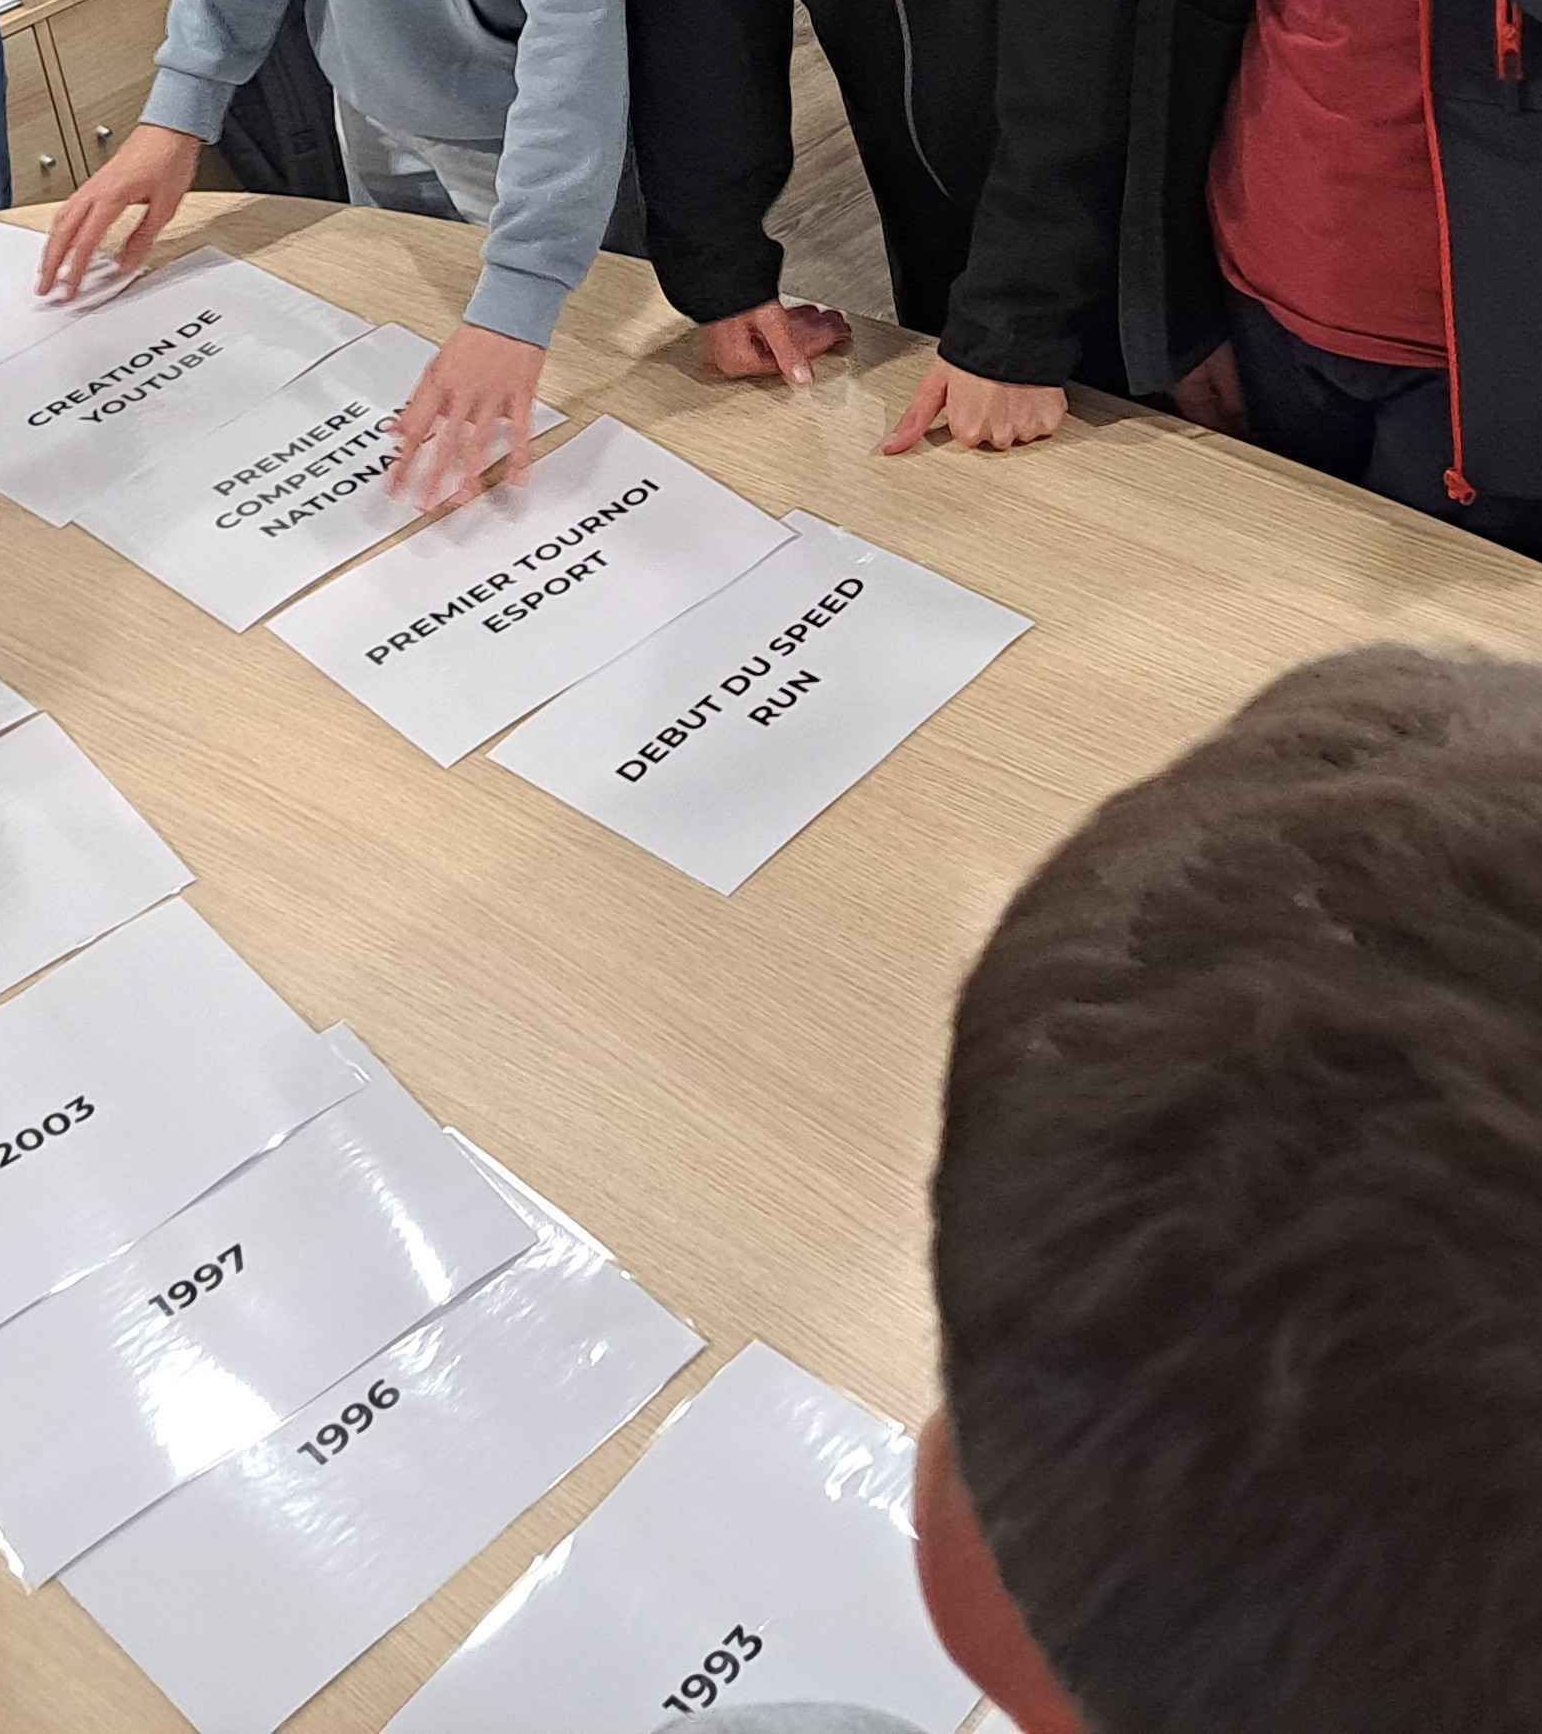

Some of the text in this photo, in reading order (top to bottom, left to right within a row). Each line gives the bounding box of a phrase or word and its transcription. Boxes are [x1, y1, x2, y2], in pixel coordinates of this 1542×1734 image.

[27, 309, 224, 428] CREATION DE
[79, 340, 224, 425] YOUTUBE
[212, 401, 371, 496] PREMIERE
[259, 446, 404, 538] NATIONA
[364, 478, 663, 666] PREMIER TOURNOI
[481, 548, 612, 635] ESPORT
[615, 575, 866, 784] DEBUT DU SPEED
[747, 669, 822, 727] RUN
[147, 1243, 248, 1318] 1997
[296, 1379, 401, 1467] 1996
[661, 1624, 763, 1719] 1993
